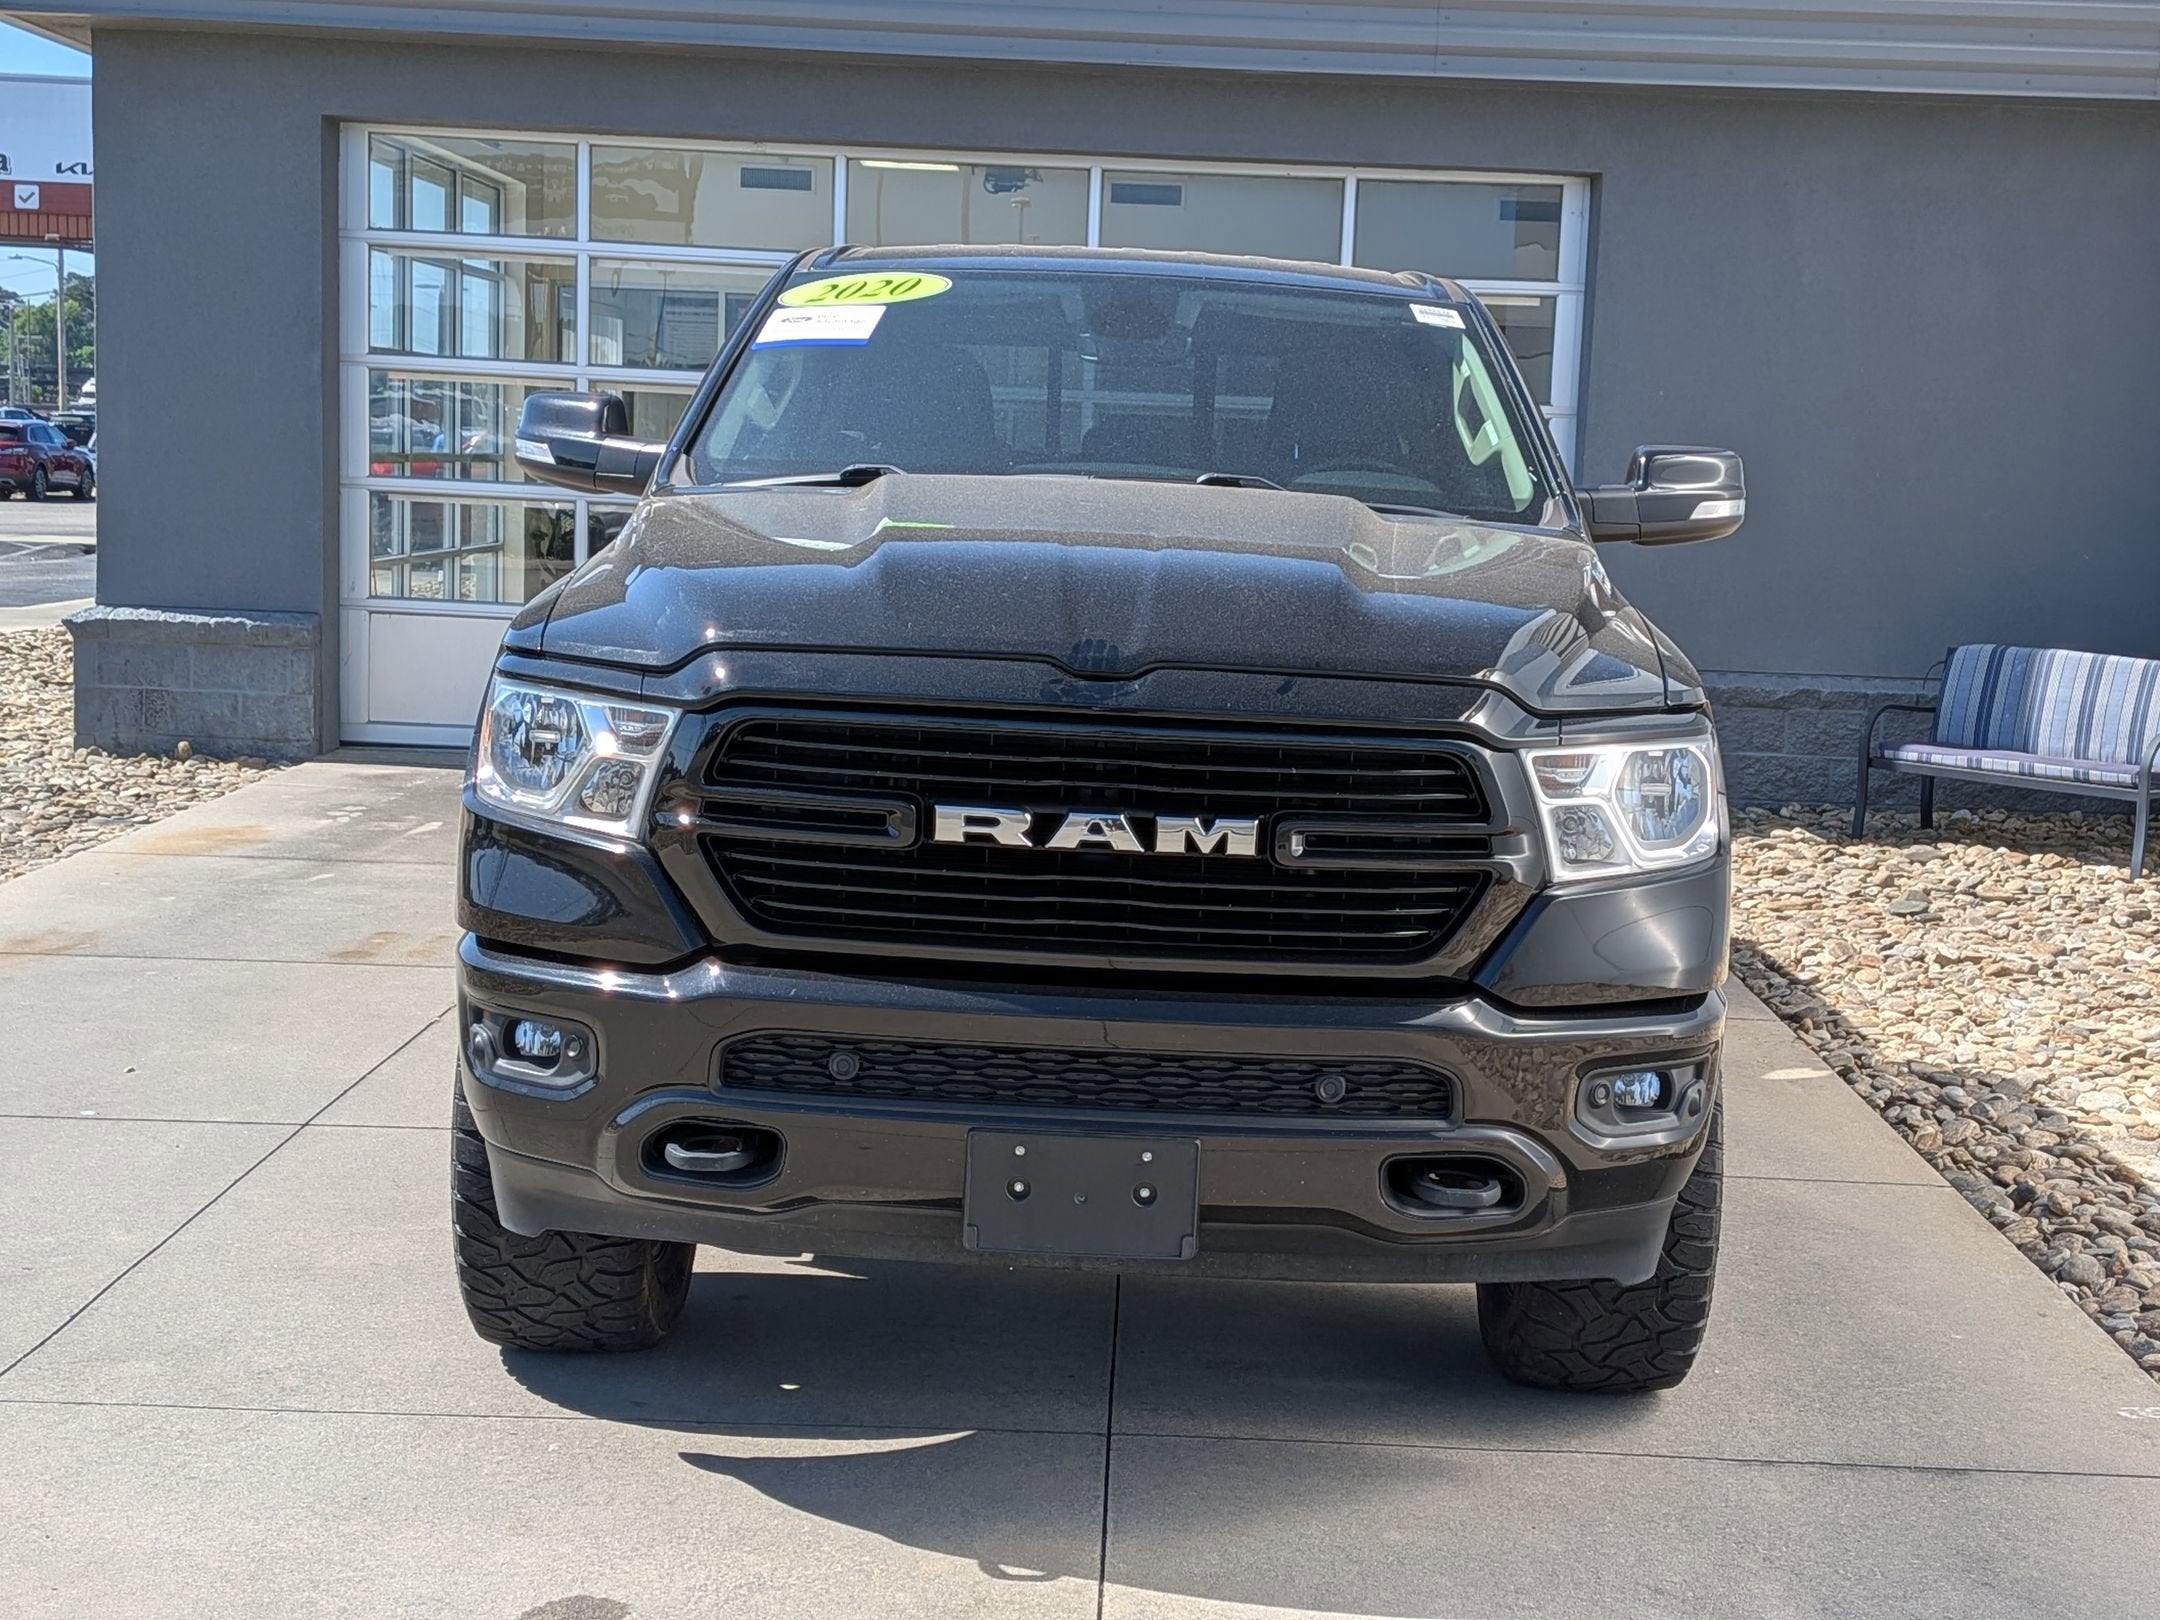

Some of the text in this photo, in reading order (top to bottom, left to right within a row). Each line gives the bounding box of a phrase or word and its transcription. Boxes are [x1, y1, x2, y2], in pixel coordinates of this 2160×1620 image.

[55, 161, 94, 176] KI
[804, 277, 922, 304] 2020
[933, 804, 1259, 857] RAM
